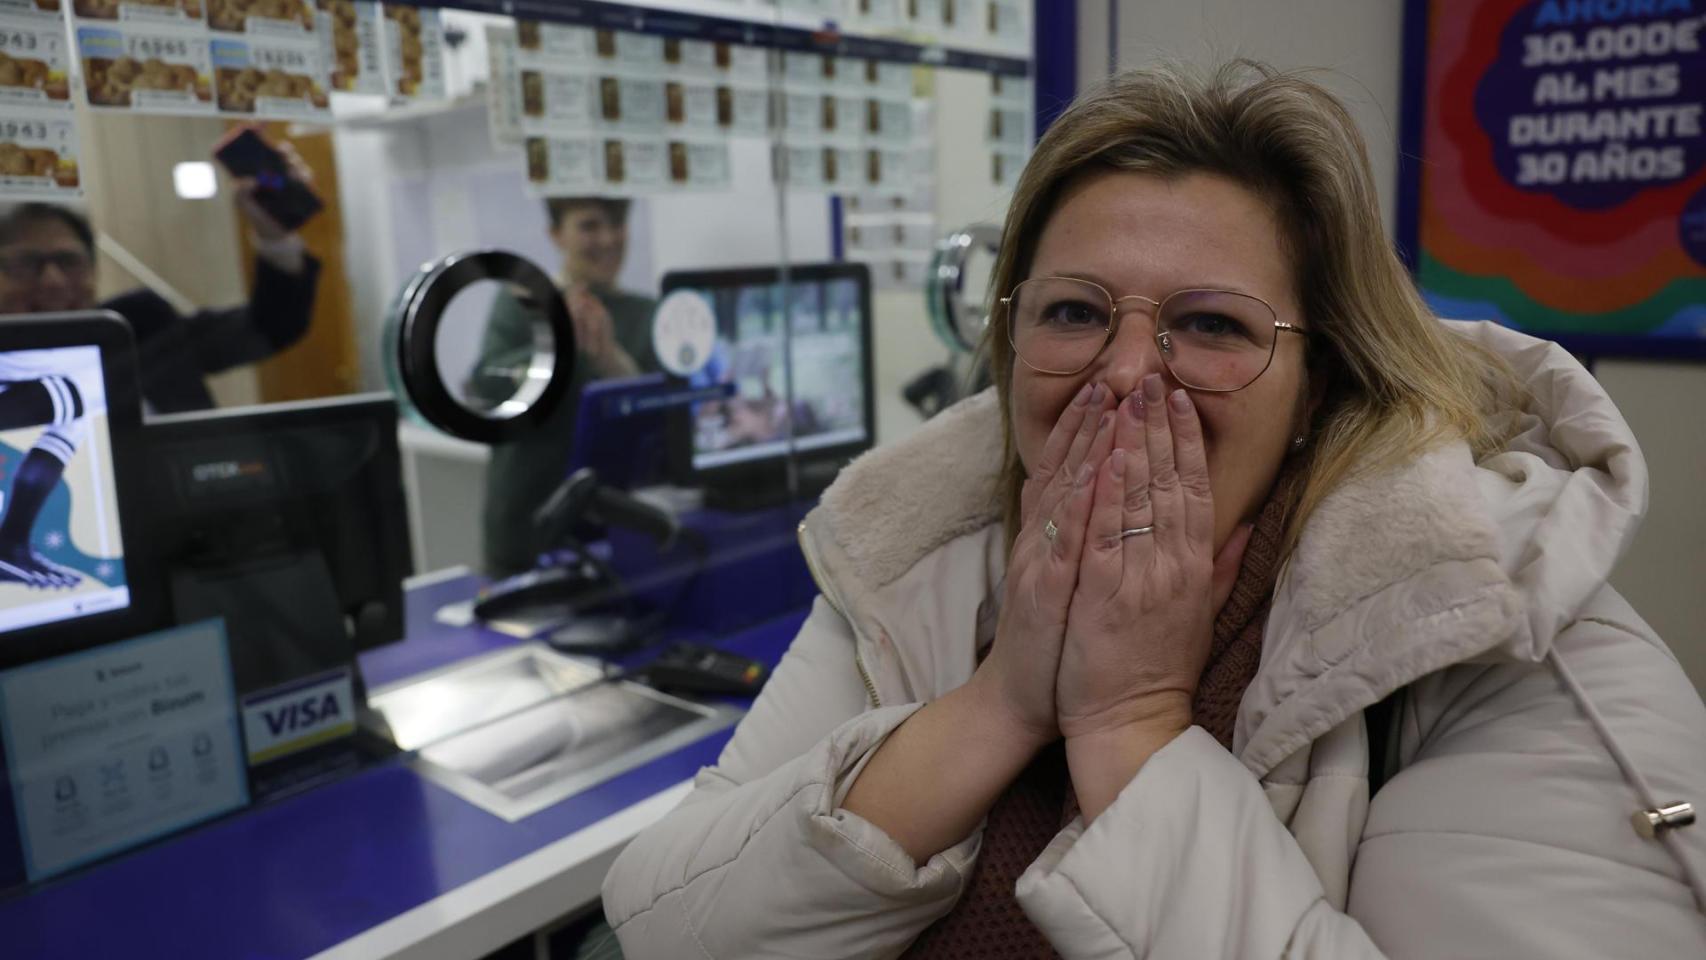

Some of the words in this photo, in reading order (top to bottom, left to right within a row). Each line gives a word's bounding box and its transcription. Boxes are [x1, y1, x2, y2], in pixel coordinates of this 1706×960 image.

[1533, 72, 1588, 106] AL
[1594, 62, 1680, 101] MES
[1508, 103, 1701, 146] DURANTE
[1516, 153, 1567, 184] 30
[1572, 139, 1684, 182] AÑOS
[263, 692, 340, 736] VISA
